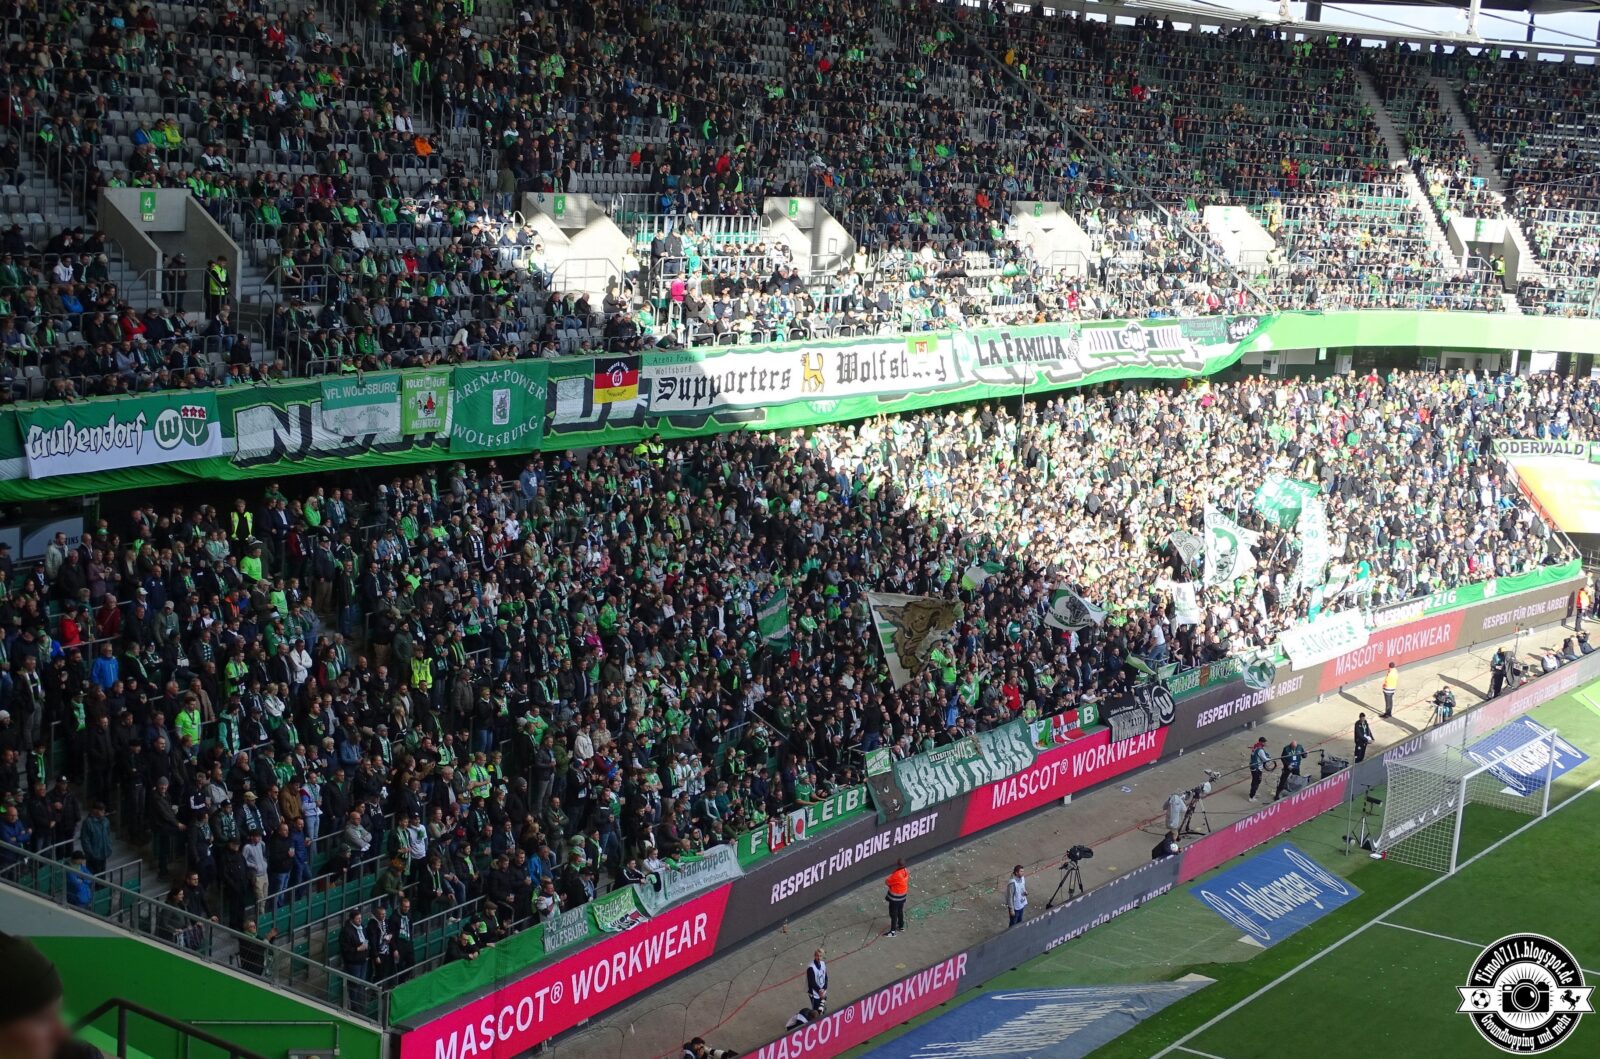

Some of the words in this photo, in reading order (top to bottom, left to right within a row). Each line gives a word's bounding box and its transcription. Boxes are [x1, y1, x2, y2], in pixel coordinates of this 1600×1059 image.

[144, 197, 152, 209] 4
[557, 199, 563, 210] 6
[973, 335, 1002, 366] LA
[1000, 332, 1067, 364] FAMILIA
[324, 388, 341, 400] VFL
[342, 382, 397, 397] WOLFSBURG
[455, 369, 545, 403] ARENA-POWER
[656, 366, 792, 407] Supporters
[27, 409, 147, 460] Grußendorf
[453, 416, 538, 448] WOLFSBURG
[1499, 441, 1584, 455] ODERWALD
[1482, 613, 1513, 630] RESPEKT
[1512, 605, 1528, 621] FÜR
[1526, 601, 1546, 617] DEINE
[1547, 595, 1569, 611] ARBEIT
[1386, 623, 1451, 657] WORKWEAR
[1196, 702, 1234, 729] RESPEKT
[1234, 693, 1252, 714] FÜR
[1251, 686, 1276, 707] DEINE
[1276, 675, 1304, 698] ARBEIT
[992, 758, 1068, 810] MASCOT®
[1072, 730, 1156, 778] WORKWEAR
[771, 860, 827, 905] RESPEKT
[828, 845, 853, 876] FÜR
[854, 830, 891, 863] DEINE
[893, 812, 939, 846] ARBEIT
[560, 906, 584, 929] ARMY
[544, 920, 589, 952] WOLFSBURG
[571, 912, 708, 1005] WORKWEAR
[860, 952, 968, 1024] WORKWEAR
